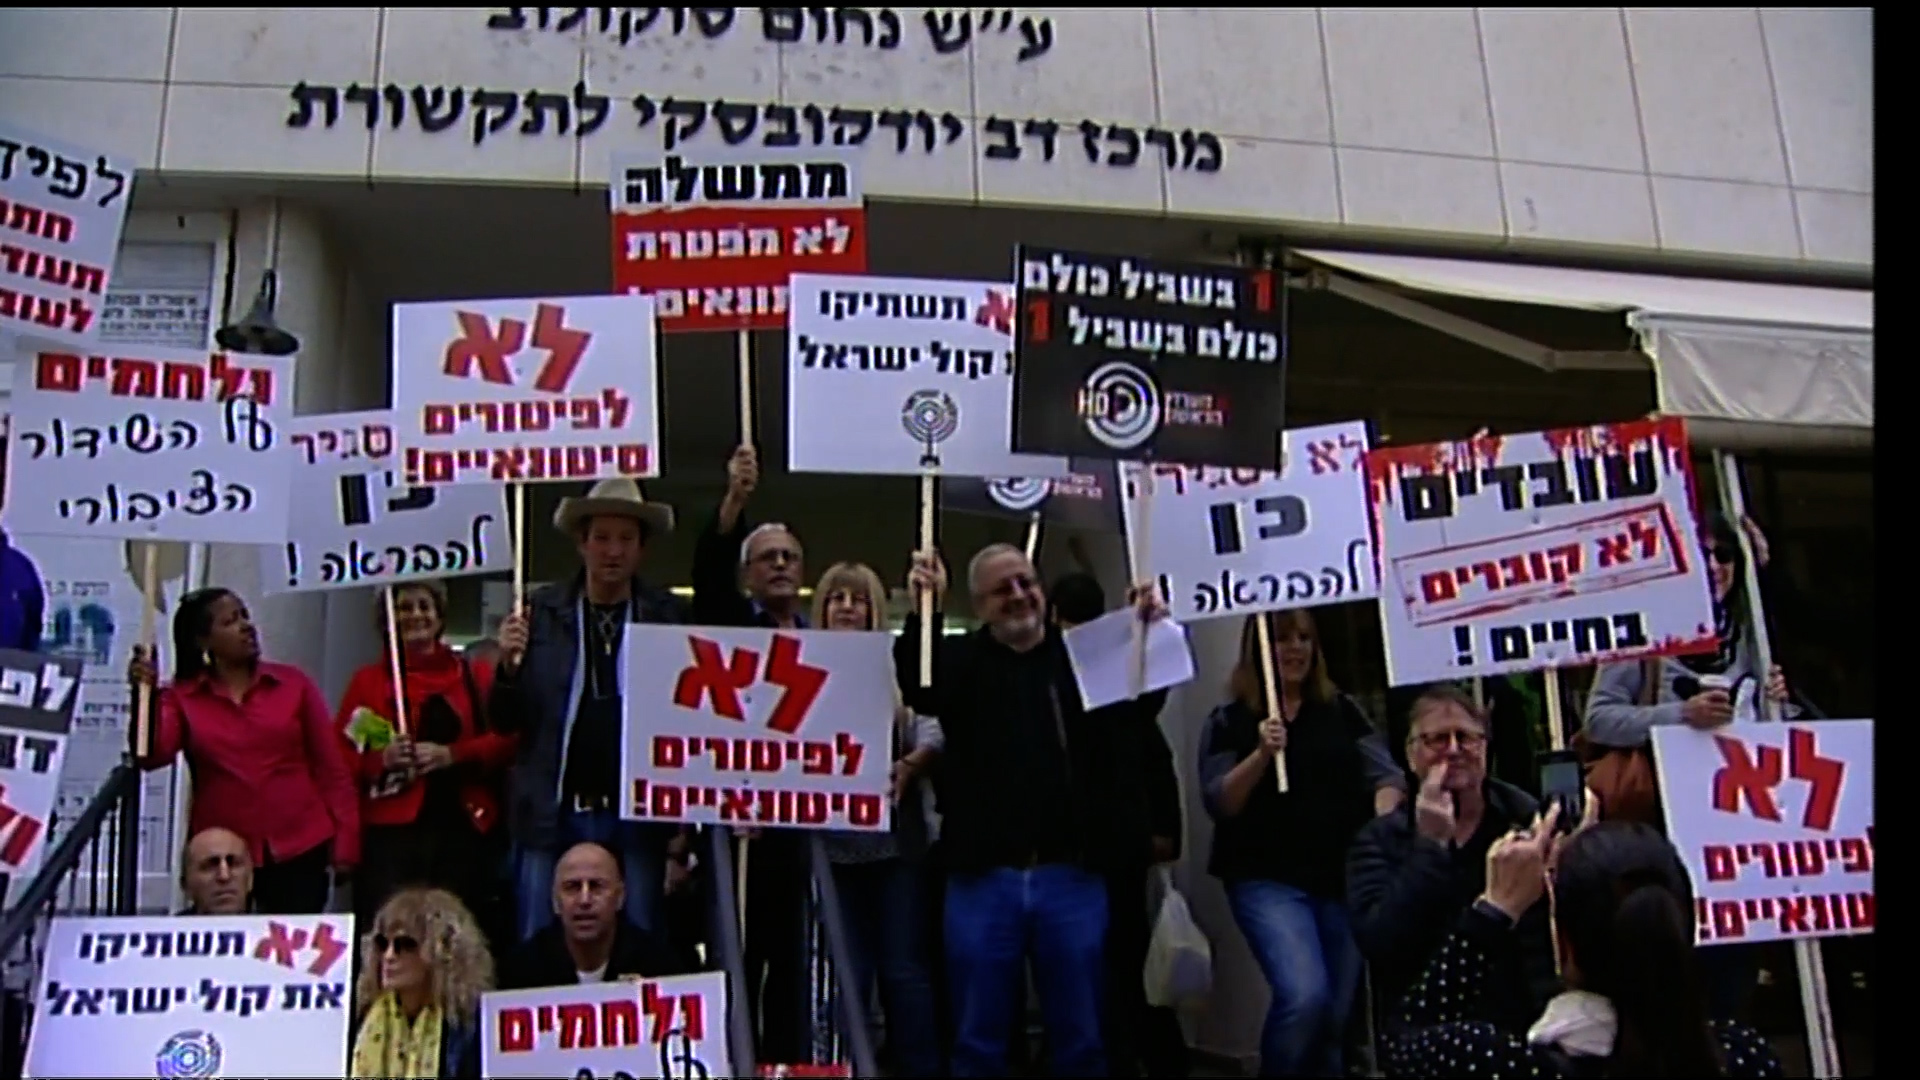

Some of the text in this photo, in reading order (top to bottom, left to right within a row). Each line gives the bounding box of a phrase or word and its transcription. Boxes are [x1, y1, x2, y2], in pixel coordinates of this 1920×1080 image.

[761, 7, 900, 50] נחום
[287, 80, 610, 146] לתקשורת
[984, 116, 1059, 161] דב
[1080, 120, 1223, 173] מרכז
[626, 156, 848, 204] ממשלה
[626, 217, 849, 261] לא מפטרת
[820, 290, 966, 321] תשתיקו
[1024, 253, 1275, 312] 1 בשביל כולם
[443, 303, 592, 393] לא
[798, 335, 919, 371] ישראל
[1027, 299, 1277, 361] כולם בשביל 1
[36, 352, 272, 406] נלחמים
[930, 341, 993, 380] קול
[20, 413, 198, 458] השידור
[424, 389, 630, 435] לפיטורים
[405, 441, 650, 484] סיטונאיים!
[1306, 433, 1366, 475] לא
[59, 469, 254, 525] הציבורי
[1401, 442, 1658, 521] עובדים
[287, 514, 493, 586] להבראה !
[1209, 494, 1308, 556] כן
[1194, 539, 1367, 612] להבראה
[1420, 519, 1661, 604] לא קוברים
[1454, 612, 1649, 666] בחיים !
[674, 633, 829, 734] לא
[653, 733, 864, 775] לפיטורים
[1712, 727, 1845, 832] לא
[634, 779, 881, 826] סיטונאיים!
[1703, 826, 1874, 882] פיטורים
[78, 921, 348, 976] לא תשתיקו
[47, 979, 346, 1017] את קול ישראל
[499, 983, 703, 1052] נלחמים
